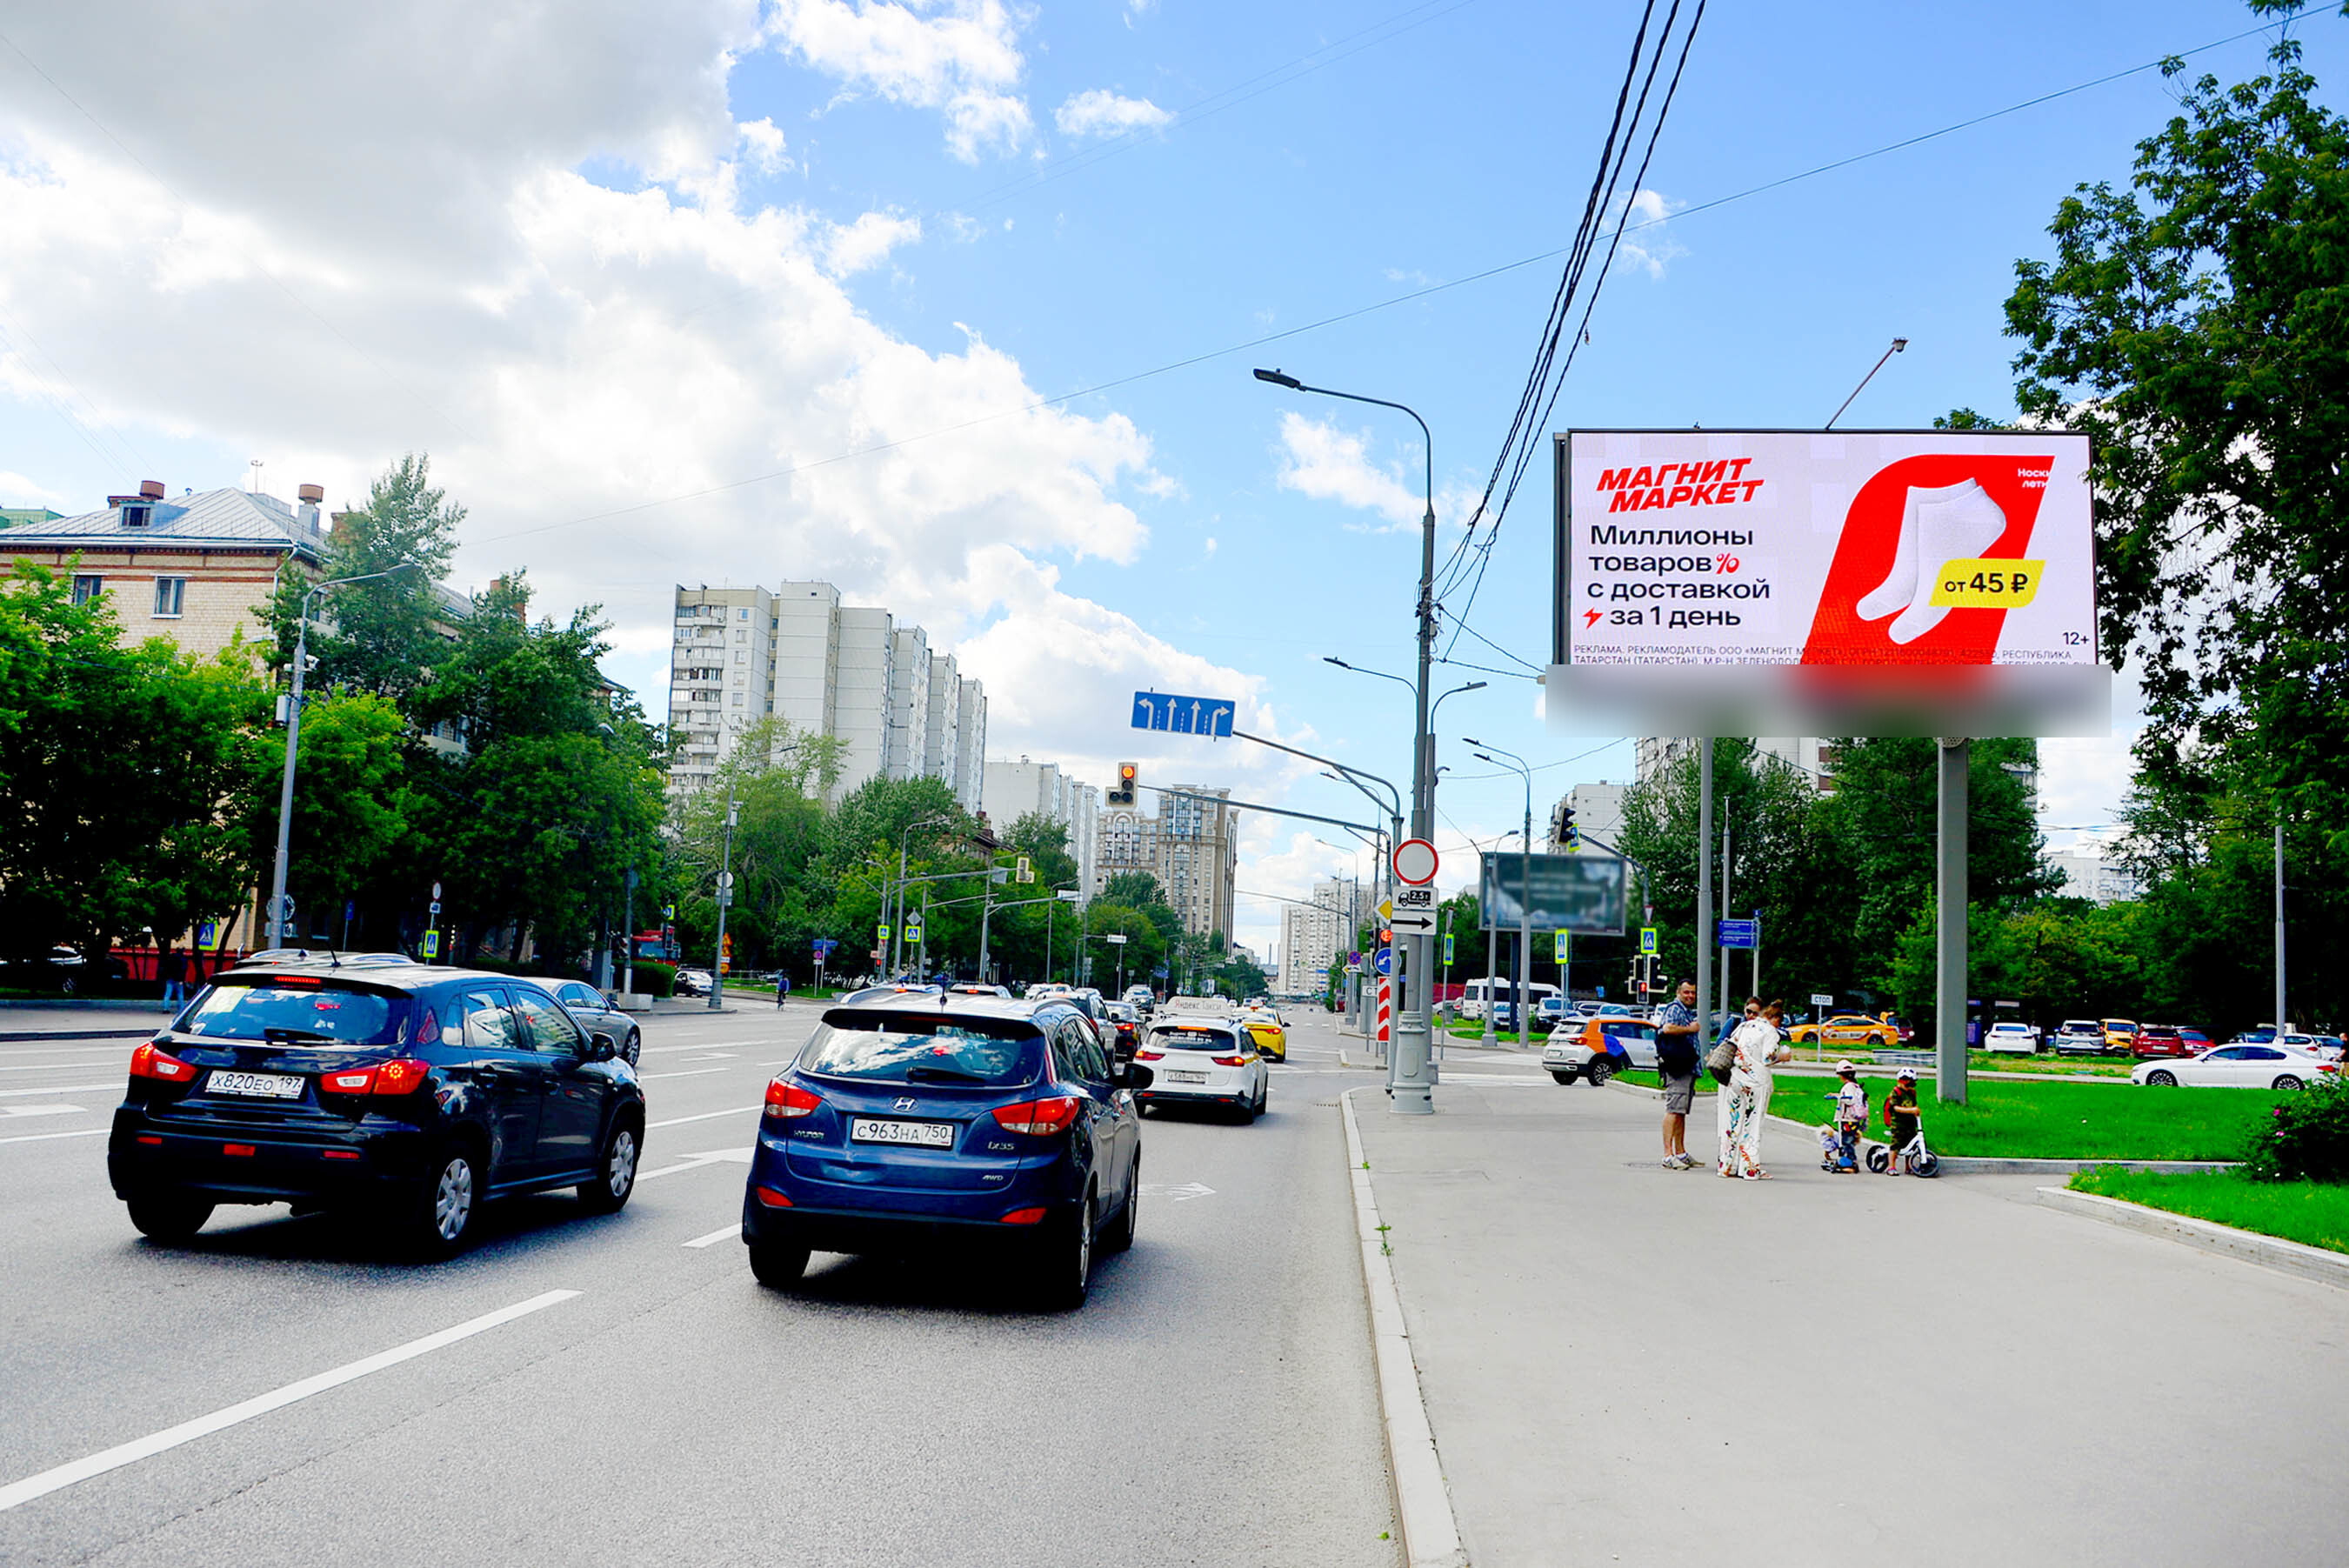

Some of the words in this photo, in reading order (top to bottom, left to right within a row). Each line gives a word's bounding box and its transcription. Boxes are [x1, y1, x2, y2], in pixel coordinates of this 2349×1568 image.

[1596, 457, 1752, 491] МАГНИТ
[1608, 479, 1765, 513] МАРКЕТ
[1591, 524, 1753, 545] Миллионы
[1588, 556, 1712, 577] товаров
[1587, 582, 1605, 598] с
[1611, 578, 1770, 602] доставкой
[1945, 581, 1966, 592] от
[1969, 572, 2005, 593] 45
[1610, 609, 1643, 625] за
[1650, 606, 1660, 625] 1
[1669, 610, 1741, 629] день
[2062, 631, 2089, 645] 12+
[1575, 656, 1631, 664] ТАТАРСТАН
[1627, 645, 1717, 656] РЕКЛАМОДАТЕЛЬ
[1718, 646, 1743, 655] ООО
[2002, 650, 2072, 659] РЕСПУБЛИКА
[924, 1125, 948, 1139] 750
